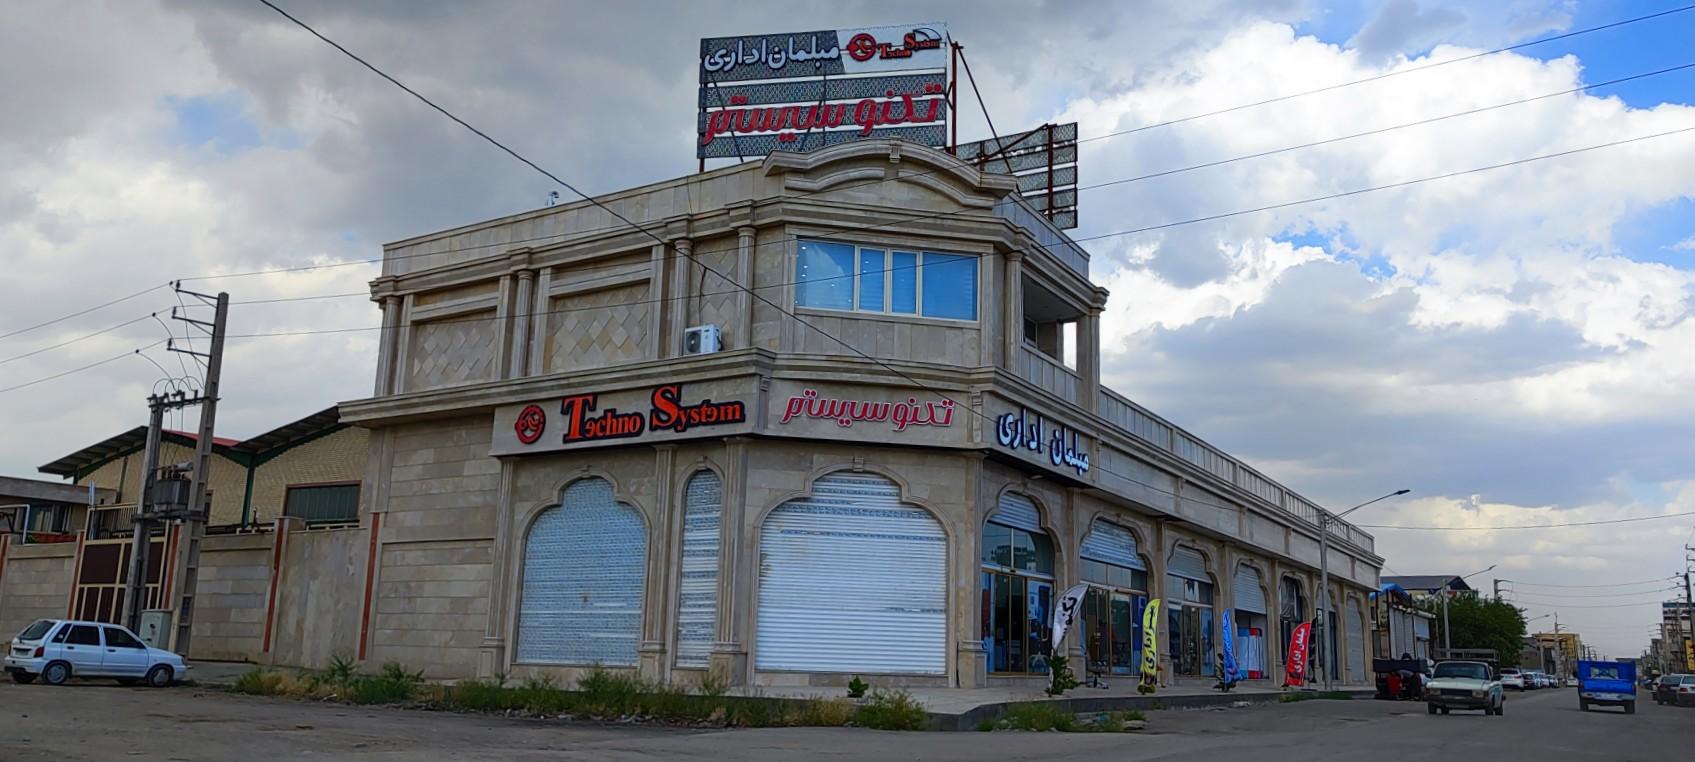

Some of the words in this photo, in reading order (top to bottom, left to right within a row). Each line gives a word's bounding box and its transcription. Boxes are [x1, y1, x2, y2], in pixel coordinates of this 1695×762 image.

[703, 38, 767, 72] اداری
[768, 34, 840, 69] مبلمان
[702, 94, 845, 145] سیستم
[853, 83, 943, 137] تکنو
[561, 393, 645, 444] Techno
[650, 382, 746, 433] System
[779, 388, 892, 428] سیستم
[890, 398, 955, 431] تکنو
[997, 407, 1043, 455] اداری
[1050, 425, 1089, 476] مبلمان
